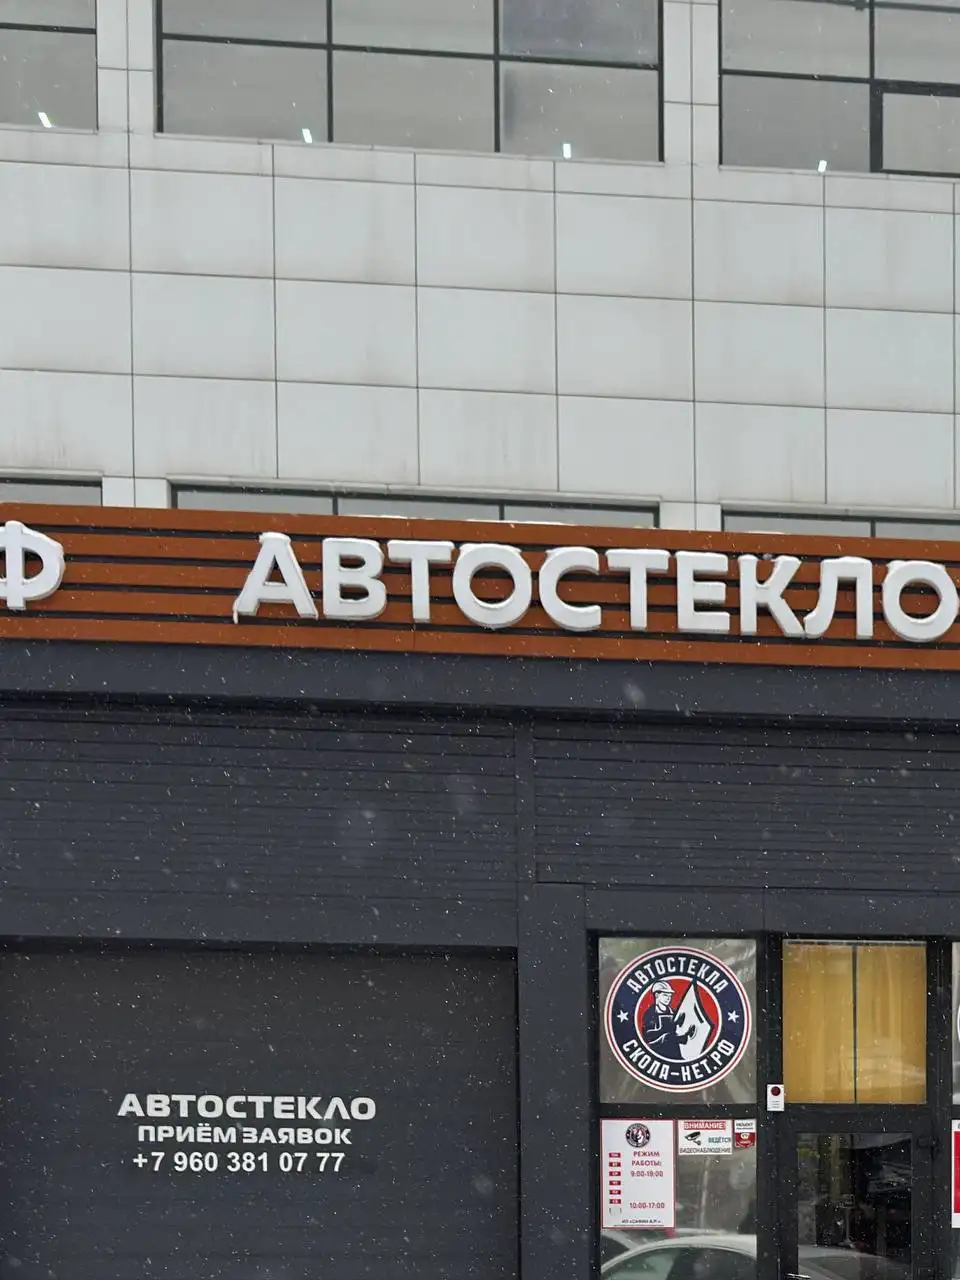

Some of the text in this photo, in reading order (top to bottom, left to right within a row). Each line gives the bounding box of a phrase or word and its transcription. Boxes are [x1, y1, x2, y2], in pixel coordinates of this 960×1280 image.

[233, 531, 960, 643] АВТОСТЕКЛО
[626, 956, 729, 994] АВТОСТЕКЛА
[622, 1039, 736, 1082] СКОЛА-НЕТ.РФ
[117, 1093, 376, 1121] АВТОСТЕКЛО
[137, 1123, 352, 1145] ПРИЁМ ЗАЯВОК
[132, 1151, 346, 1172] +7 960 381 07 77
